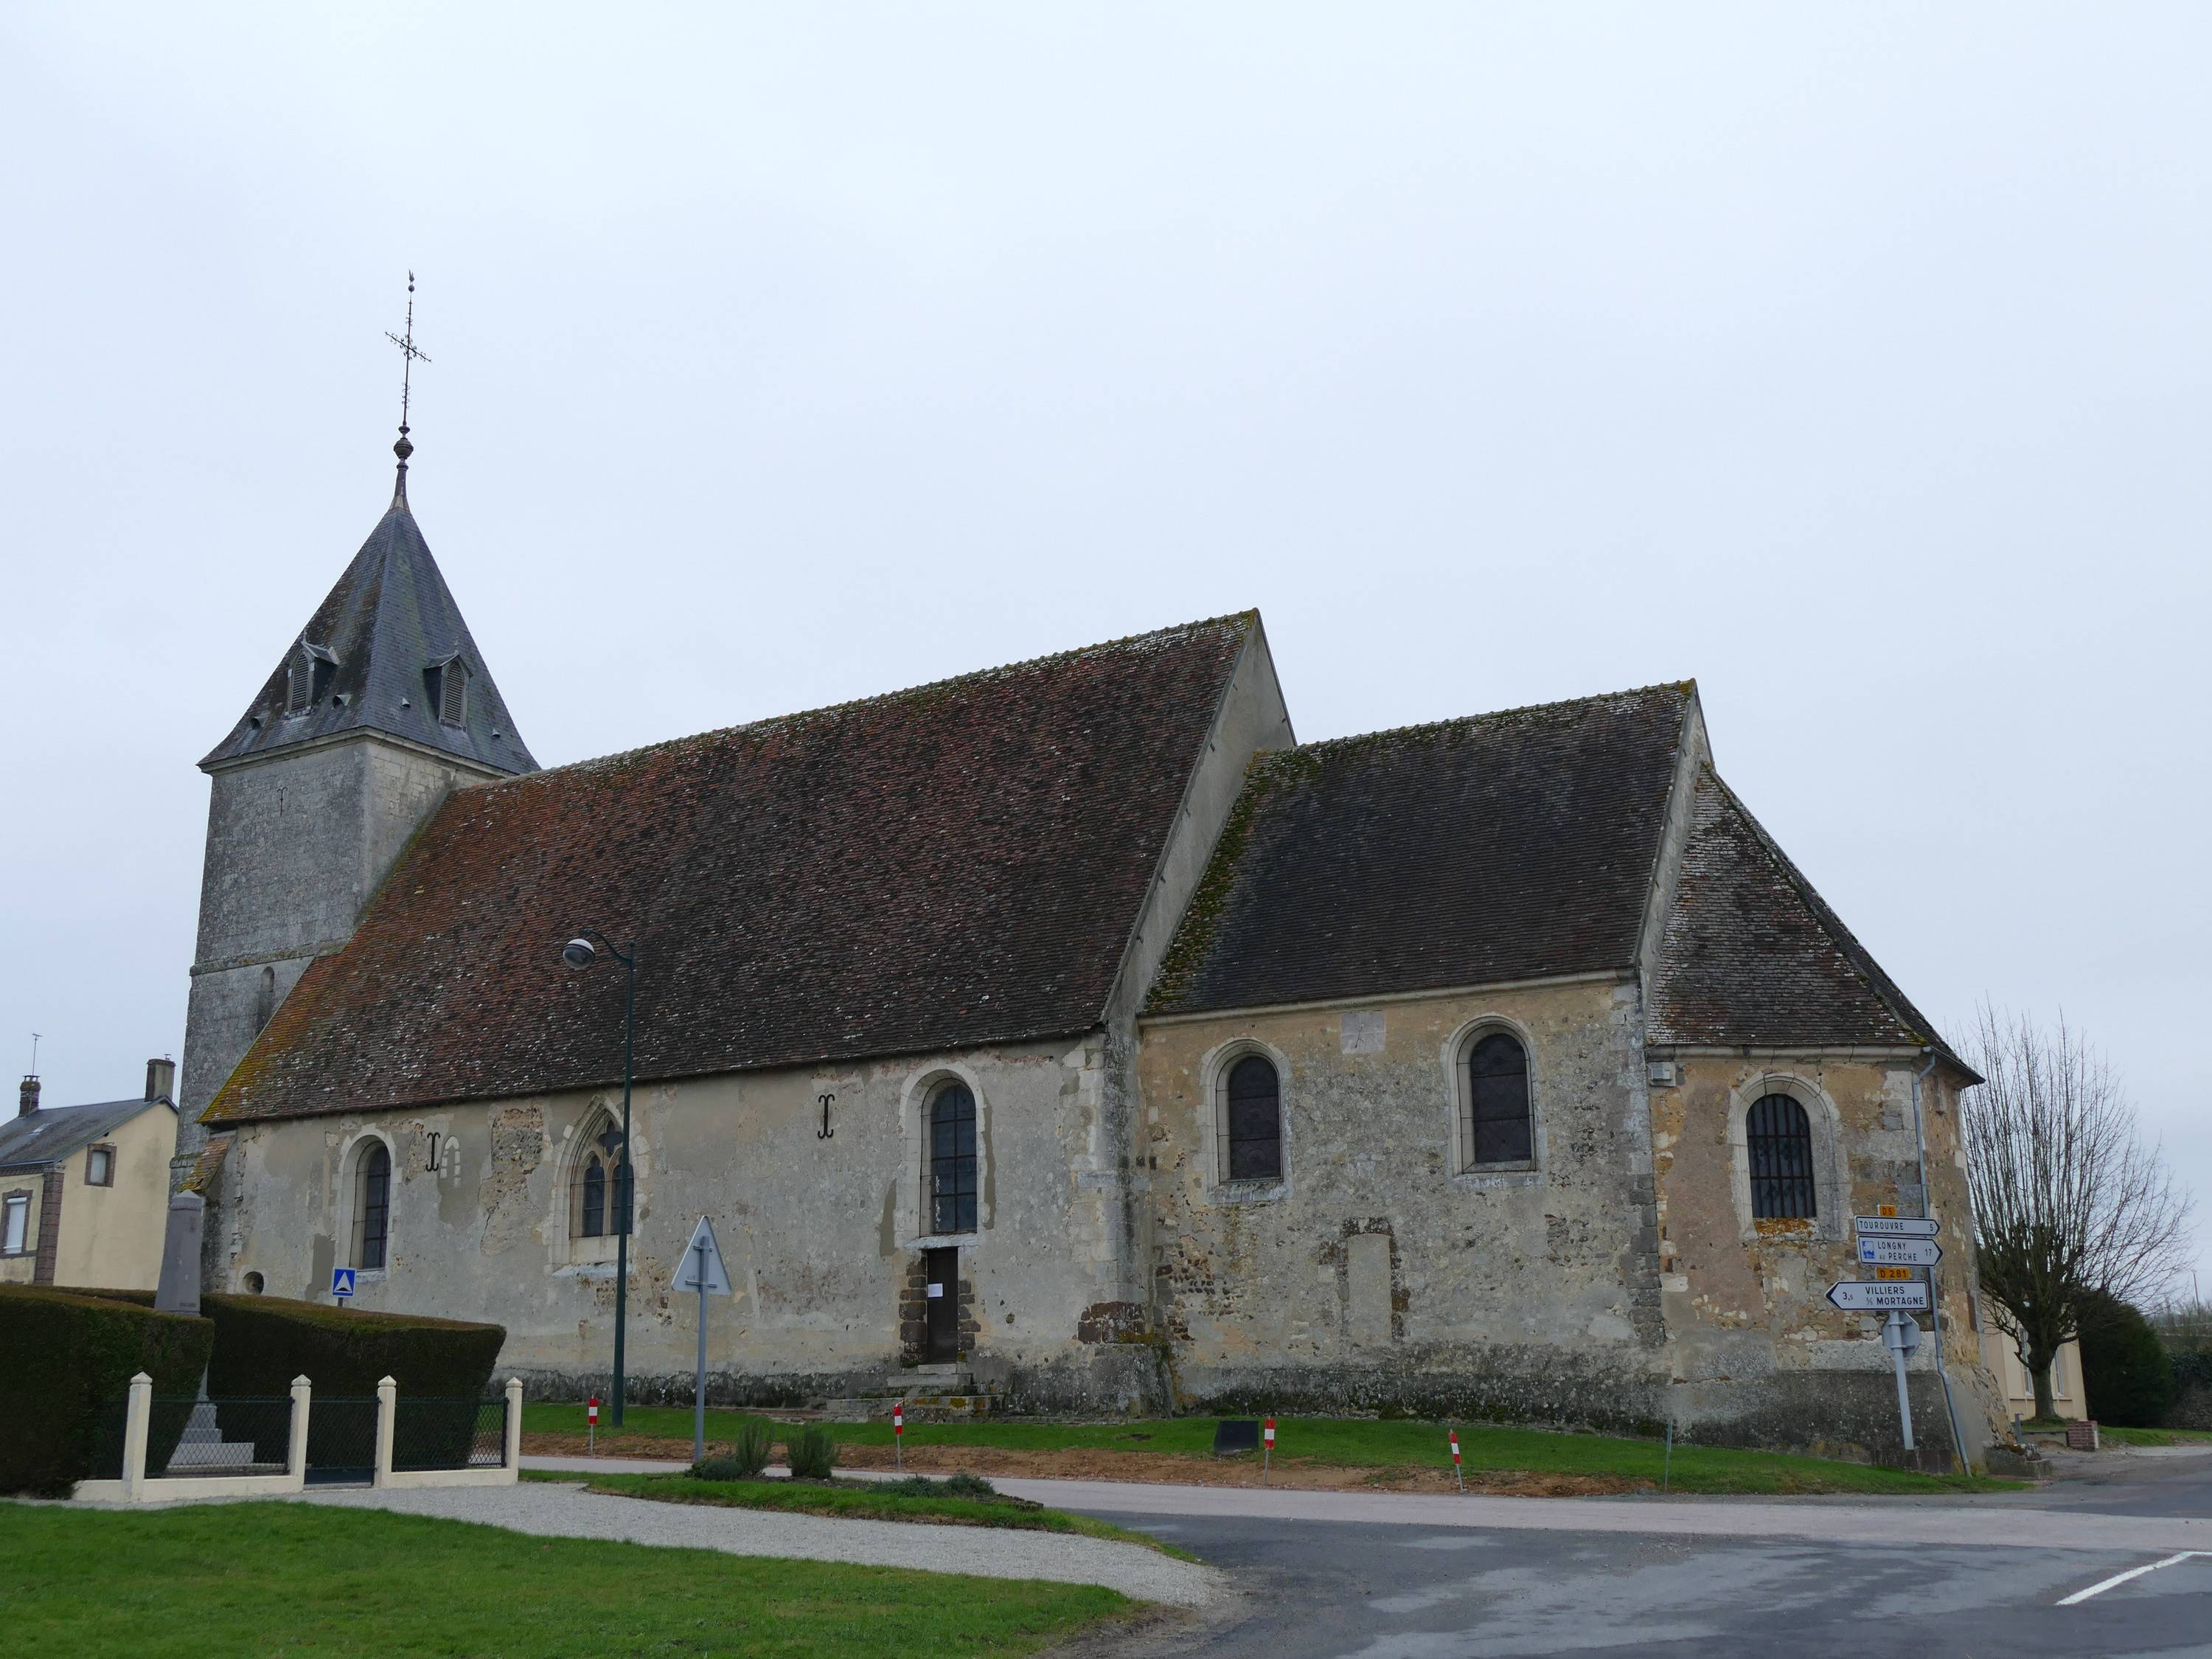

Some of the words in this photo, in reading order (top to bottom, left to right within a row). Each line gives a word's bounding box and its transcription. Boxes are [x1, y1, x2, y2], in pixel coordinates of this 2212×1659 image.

[1860, 1221, 1904, 1231] TOUROUVRE
[1929, 1223, 1934, 1231] 5
[1877, 1242, 1906, 1250] LONGNY
[1924, 1248, 1933, 1256] 17
[1888, 1252, 1917, 1261] PERCHE
[1880, 1270, 1885, 1279] D
[1890, 1269, 1907, 1278] 281
[1865, 1286, 1905, 1295] VILLIERS
[1877, 1297, 1924, 1305] MORTAGNE
